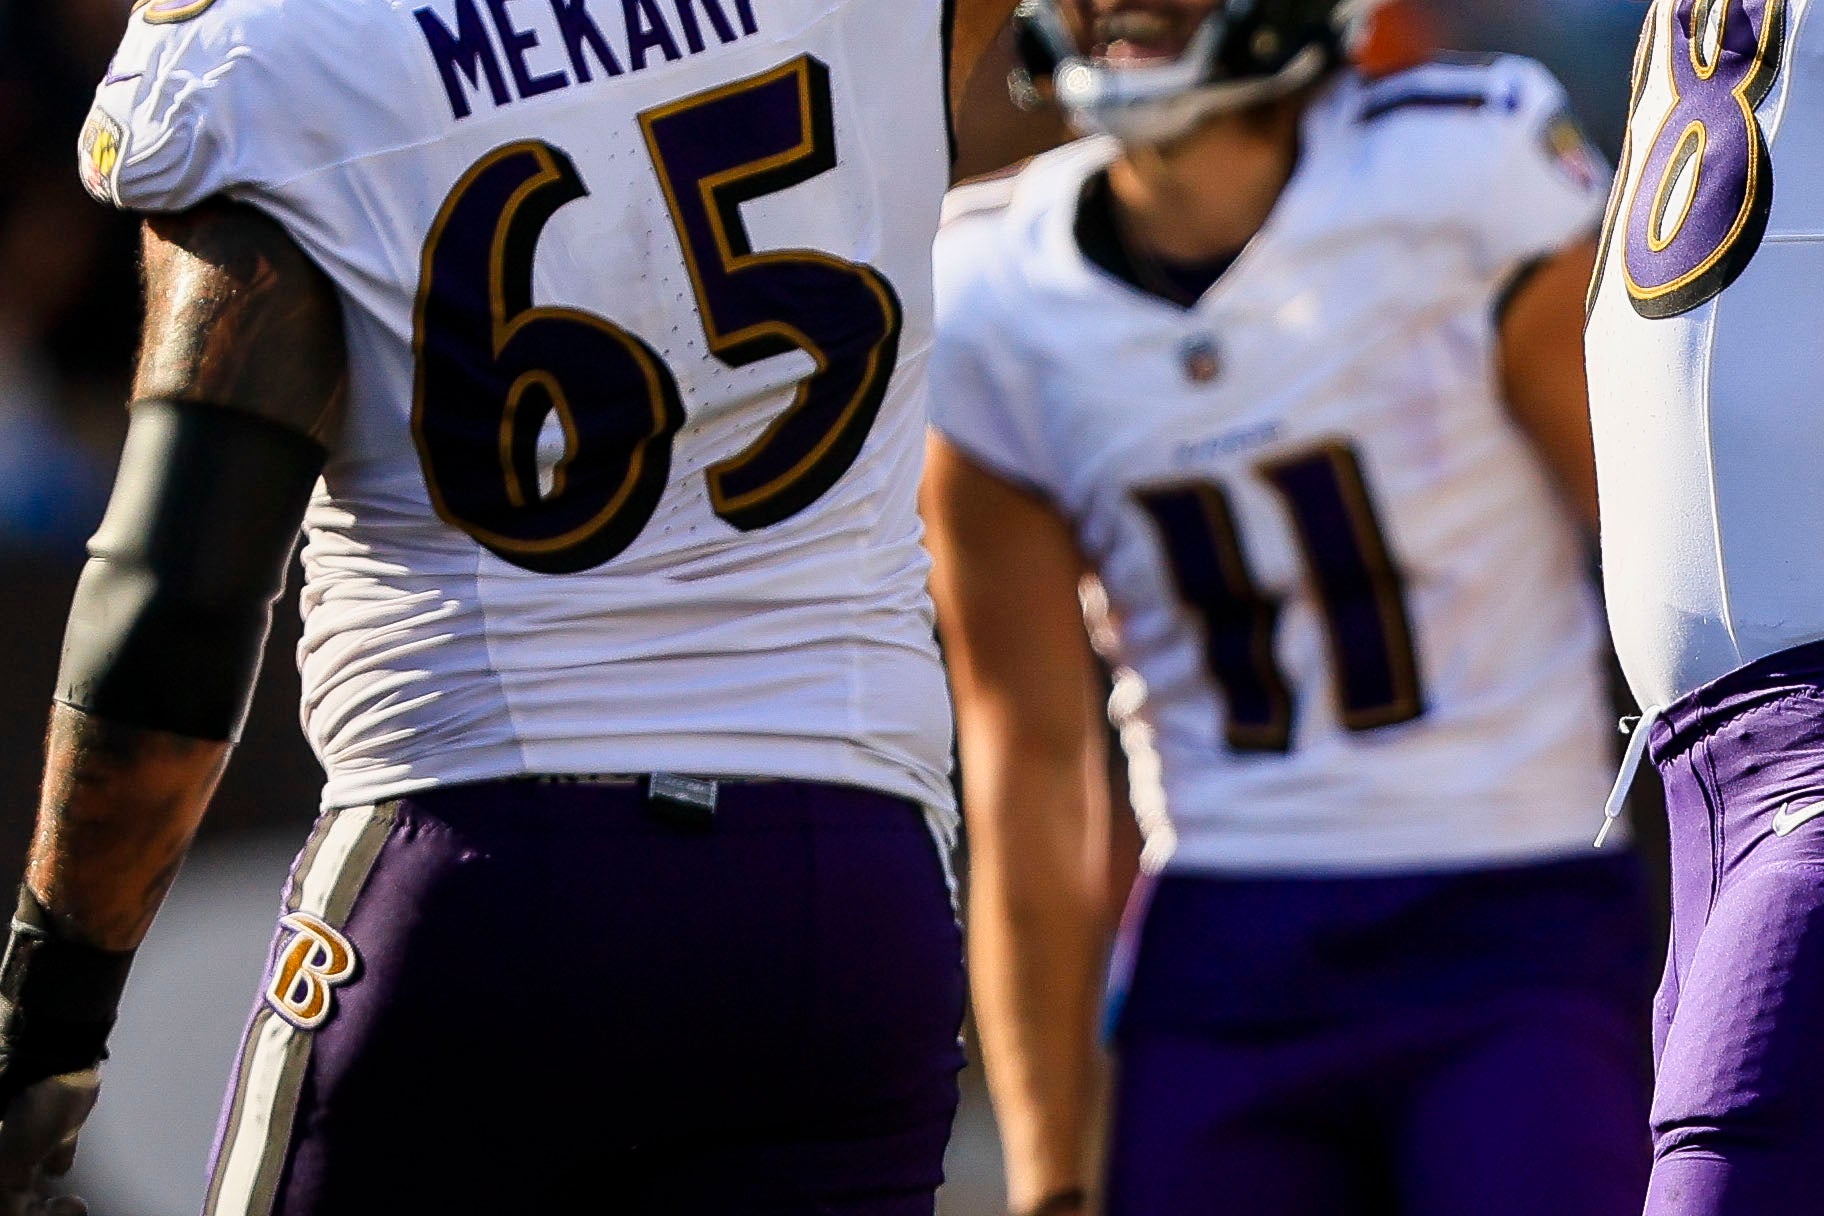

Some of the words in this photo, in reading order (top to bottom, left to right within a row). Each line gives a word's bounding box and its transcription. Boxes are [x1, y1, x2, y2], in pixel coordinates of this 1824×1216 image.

[411, 53, 903, 574] 65
[1129, 437, 1429, 756] 11
[266, 911, 361, 1030] B
